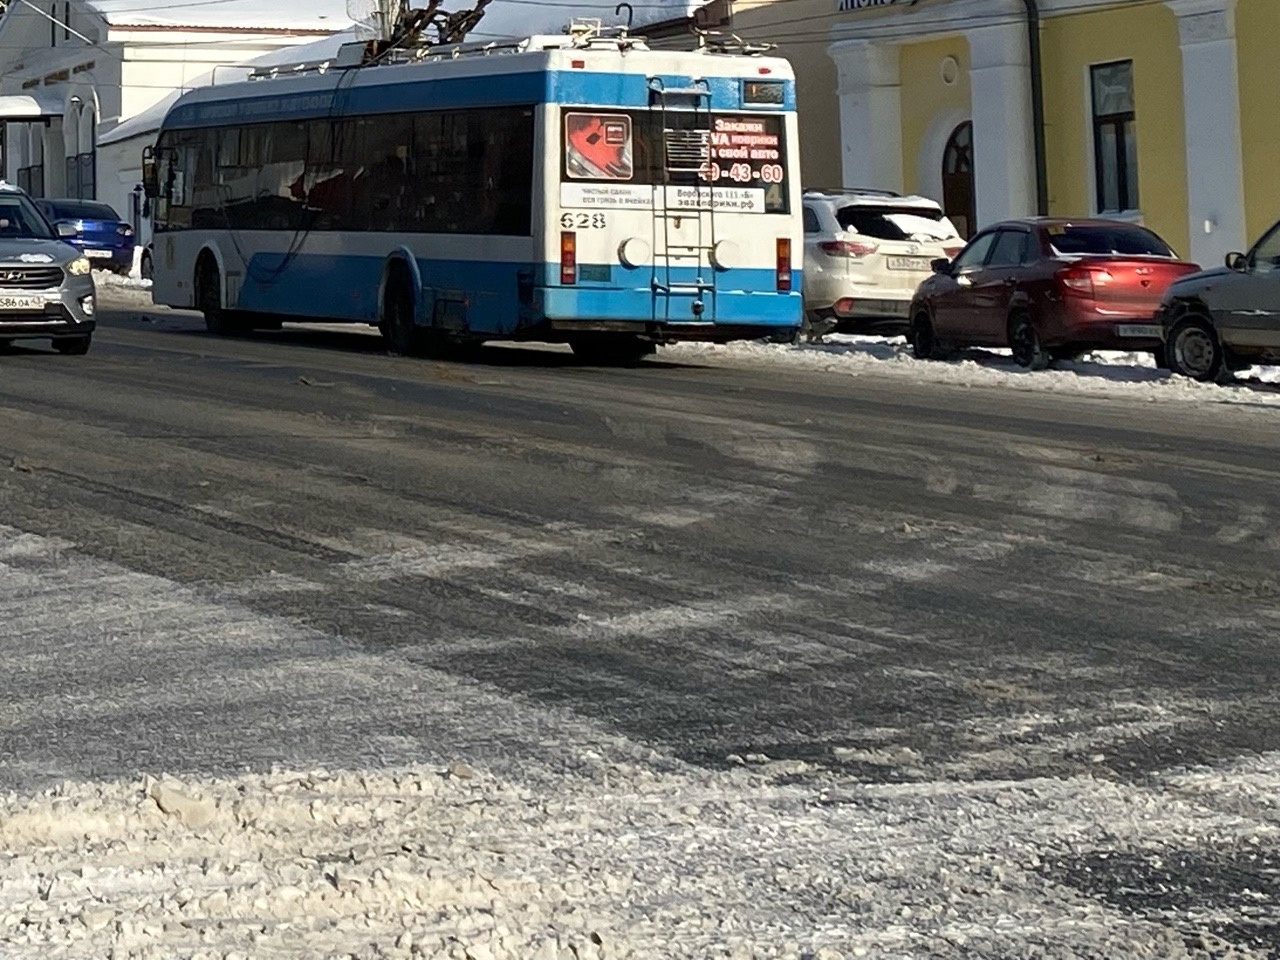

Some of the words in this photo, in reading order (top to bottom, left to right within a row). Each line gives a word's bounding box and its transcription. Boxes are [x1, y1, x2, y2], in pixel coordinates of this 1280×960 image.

[719, 146, 748, 158] свой
[750, 149, 779, 159] авто
[560, 213, 607, 229] 628
